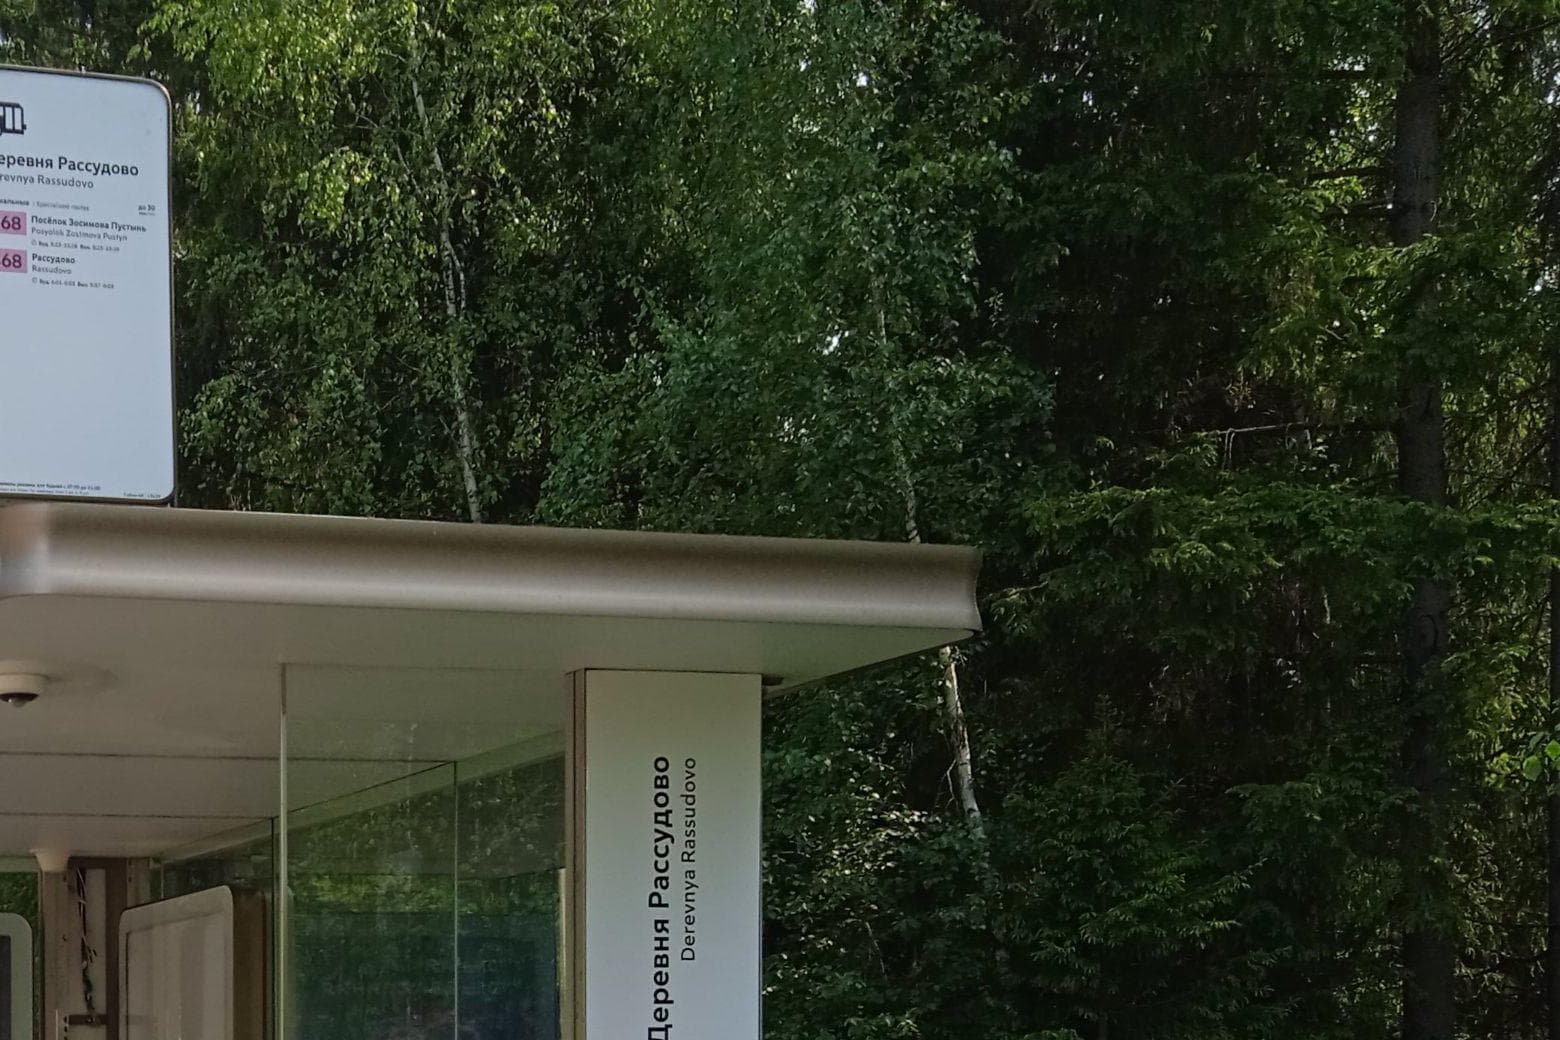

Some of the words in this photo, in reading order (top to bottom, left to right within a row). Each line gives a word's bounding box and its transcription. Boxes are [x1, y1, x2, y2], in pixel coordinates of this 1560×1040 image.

[58, 156, 139, 176] Рассудово
[38, 174, 94, 188] Rassudovo
[31, 215, 67, 226] Посёлок
[69, 218, 109, 229] Зосимова
[111, 221, 146, 232] Пустынь
[32, 253, 75, 264] Рассудово
[680, 757, 696, 863] Rassudovo
[648, 756, 674, 908] Рассудово
[680, 869, 699, 961] Derevnya
